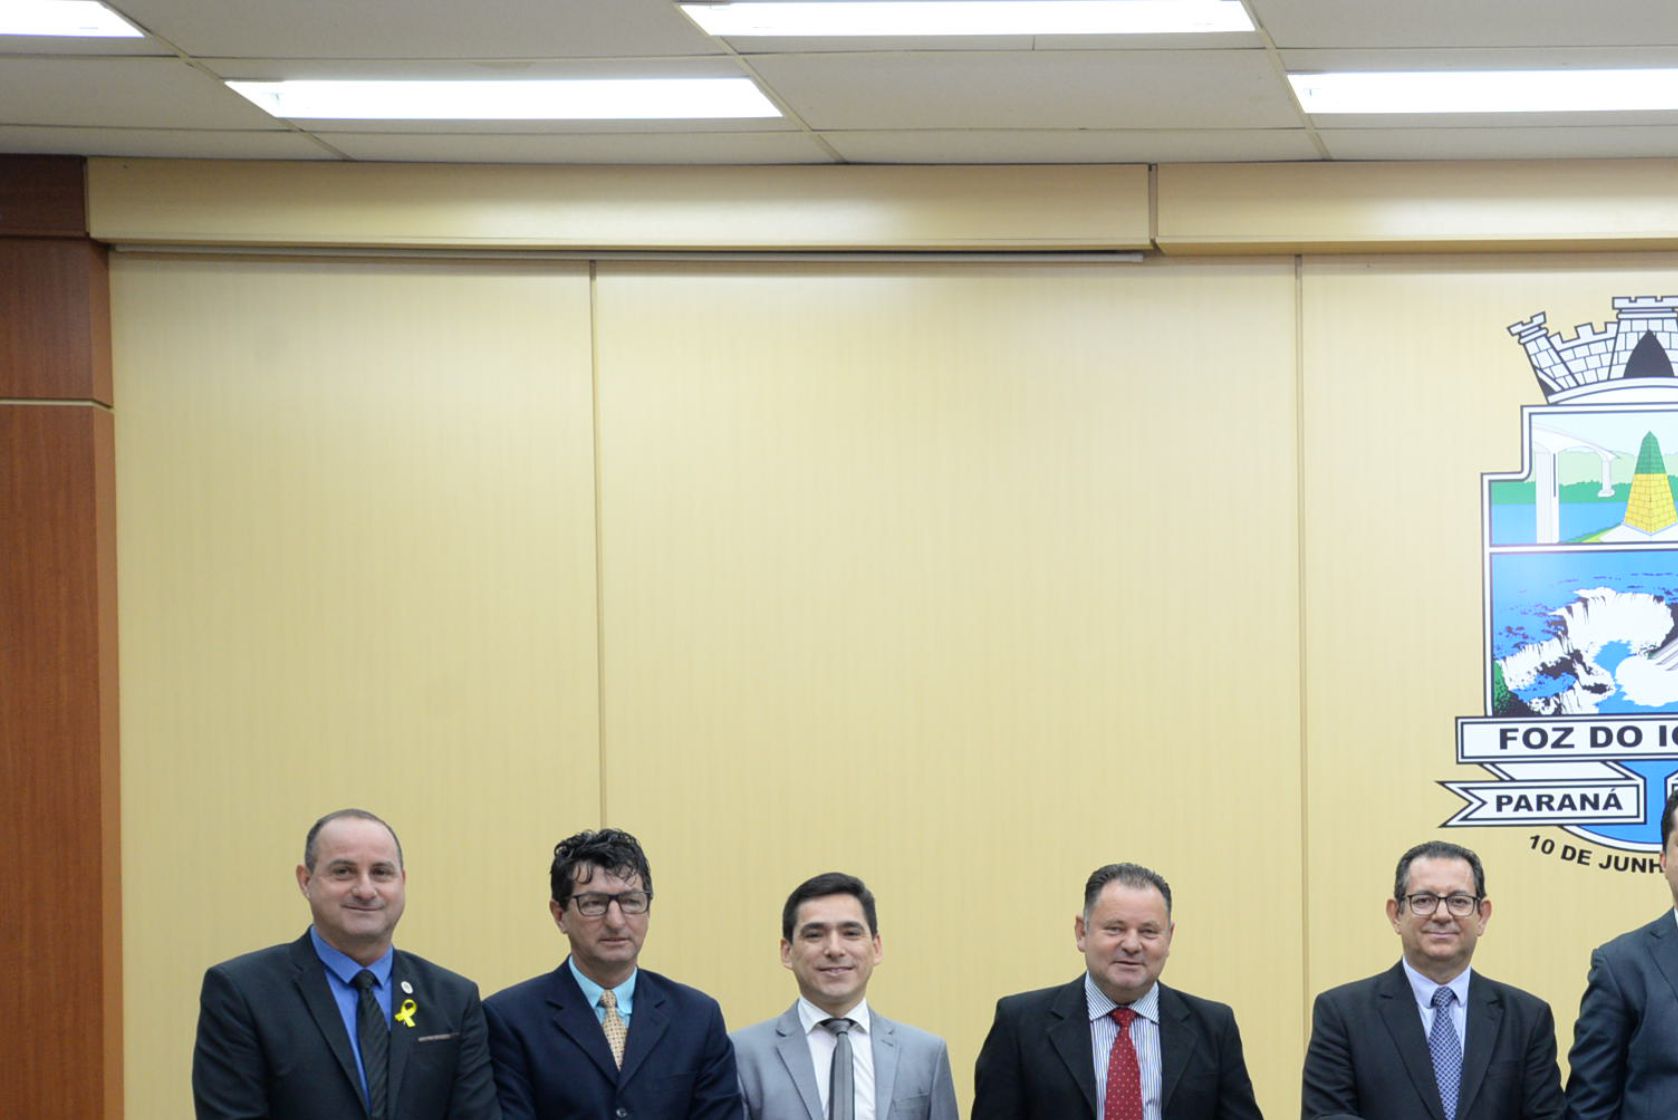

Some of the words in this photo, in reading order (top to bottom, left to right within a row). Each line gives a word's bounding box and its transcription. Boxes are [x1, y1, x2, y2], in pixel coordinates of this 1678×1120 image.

[1499, 727, 1575, 750] FOZ
[1589, 725, 1643, 748] DO
[1495, 788, 1624, 812] PARANÁ
[1529, 833, 1555, 856] 10
[1561, 845, 1592, 866] DE
[1600, 855, 1665, 875] JUNH
